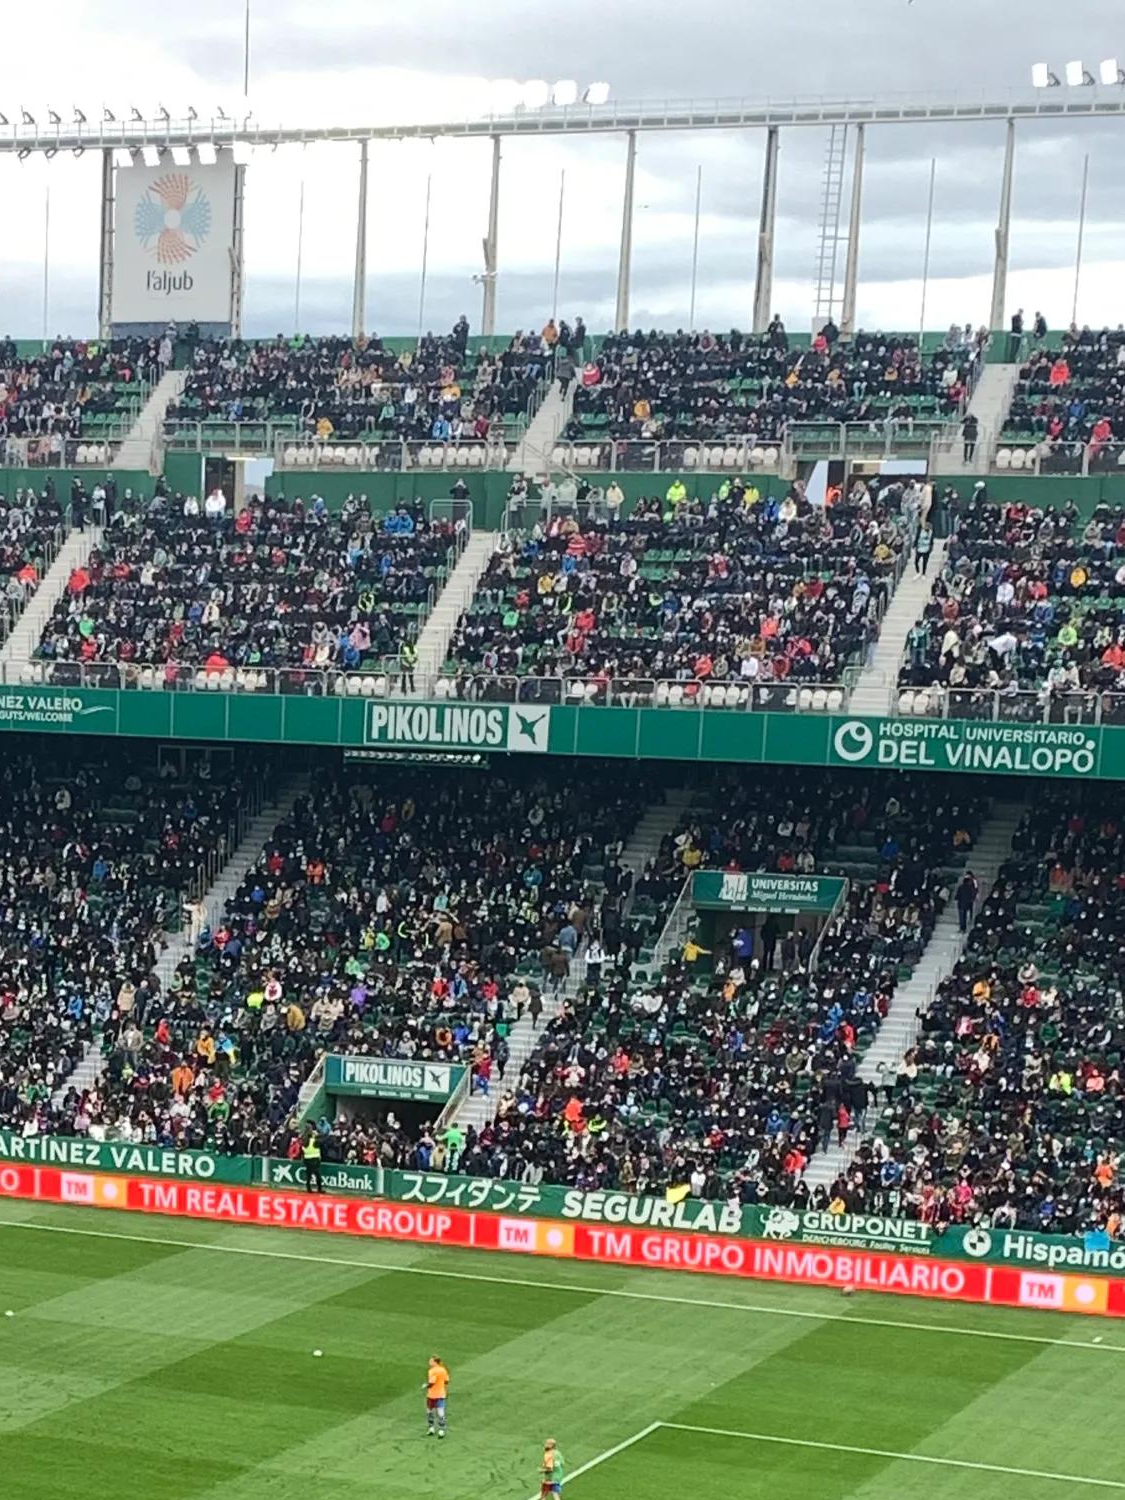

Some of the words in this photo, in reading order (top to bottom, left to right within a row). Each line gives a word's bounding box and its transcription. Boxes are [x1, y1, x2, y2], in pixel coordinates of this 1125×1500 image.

[146, 269, 193, 296] l'aljub
[27, 696, 83, 712] VALERO
[371, 704, 503, 745] PIKOLINOS
[879, 722, 960, 740] HOSPITAL
[966, 727, 1085, 746] UNIVERSITARIO
[877, 739, 935, 765] DEL
[751, 878, 819, 892] UNIVERSITAS
[345, 1062, 422, 1088] PIKOLINOS
[111, 1146, 216, 1178] VALERO
[401, 1173, 541, 1213] スフィダンテ
[139, 1183, 177, 1209] TM
[186, 1188, 250, 1217] REAL
[257, 1196, 348, 1227] ESTATE
[356, 1206, 452, 1239] GROUP
[561, 1190, 743, 1234] SEGURLAB
[504, 1227, 529, 1244] TM
[802, 1211, 932, 1241] GRUPONET
[588, 1231, 631, 1259] TM
[641, 1236, 745, 1270] GRUPO
[754, 1248, 965, 1293] INMOBILIARIO
[1027, 1281, 1055, 1300] TM
